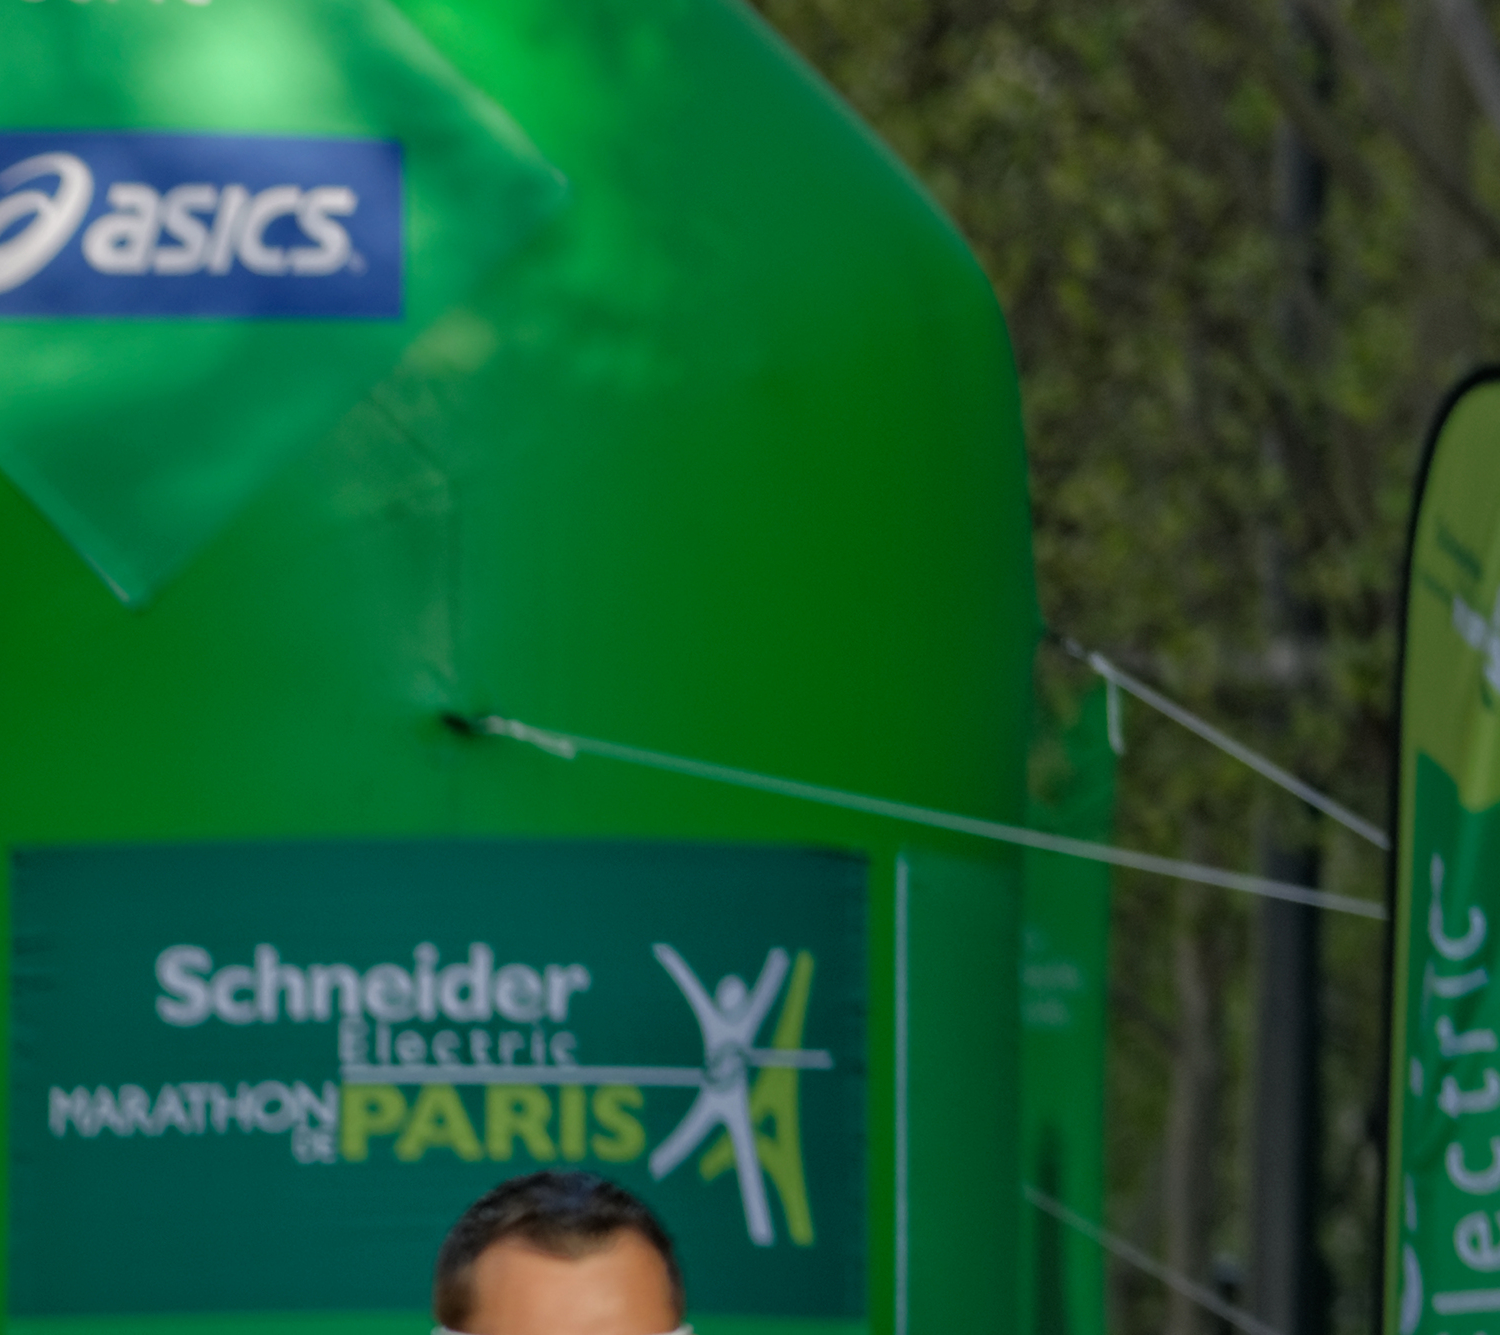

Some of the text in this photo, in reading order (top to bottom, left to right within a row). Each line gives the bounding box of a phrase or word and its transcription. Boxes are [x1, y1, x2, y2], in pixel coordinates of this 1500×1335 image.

[82, 182, 357, 277] asics
[154, 942, 591, 1026] Schneider
[337, 1016, 577, 1067] Electric
[48, 1080, 338, 1138] MARATHON
[339, 1082, 646, 1163] PARIS
